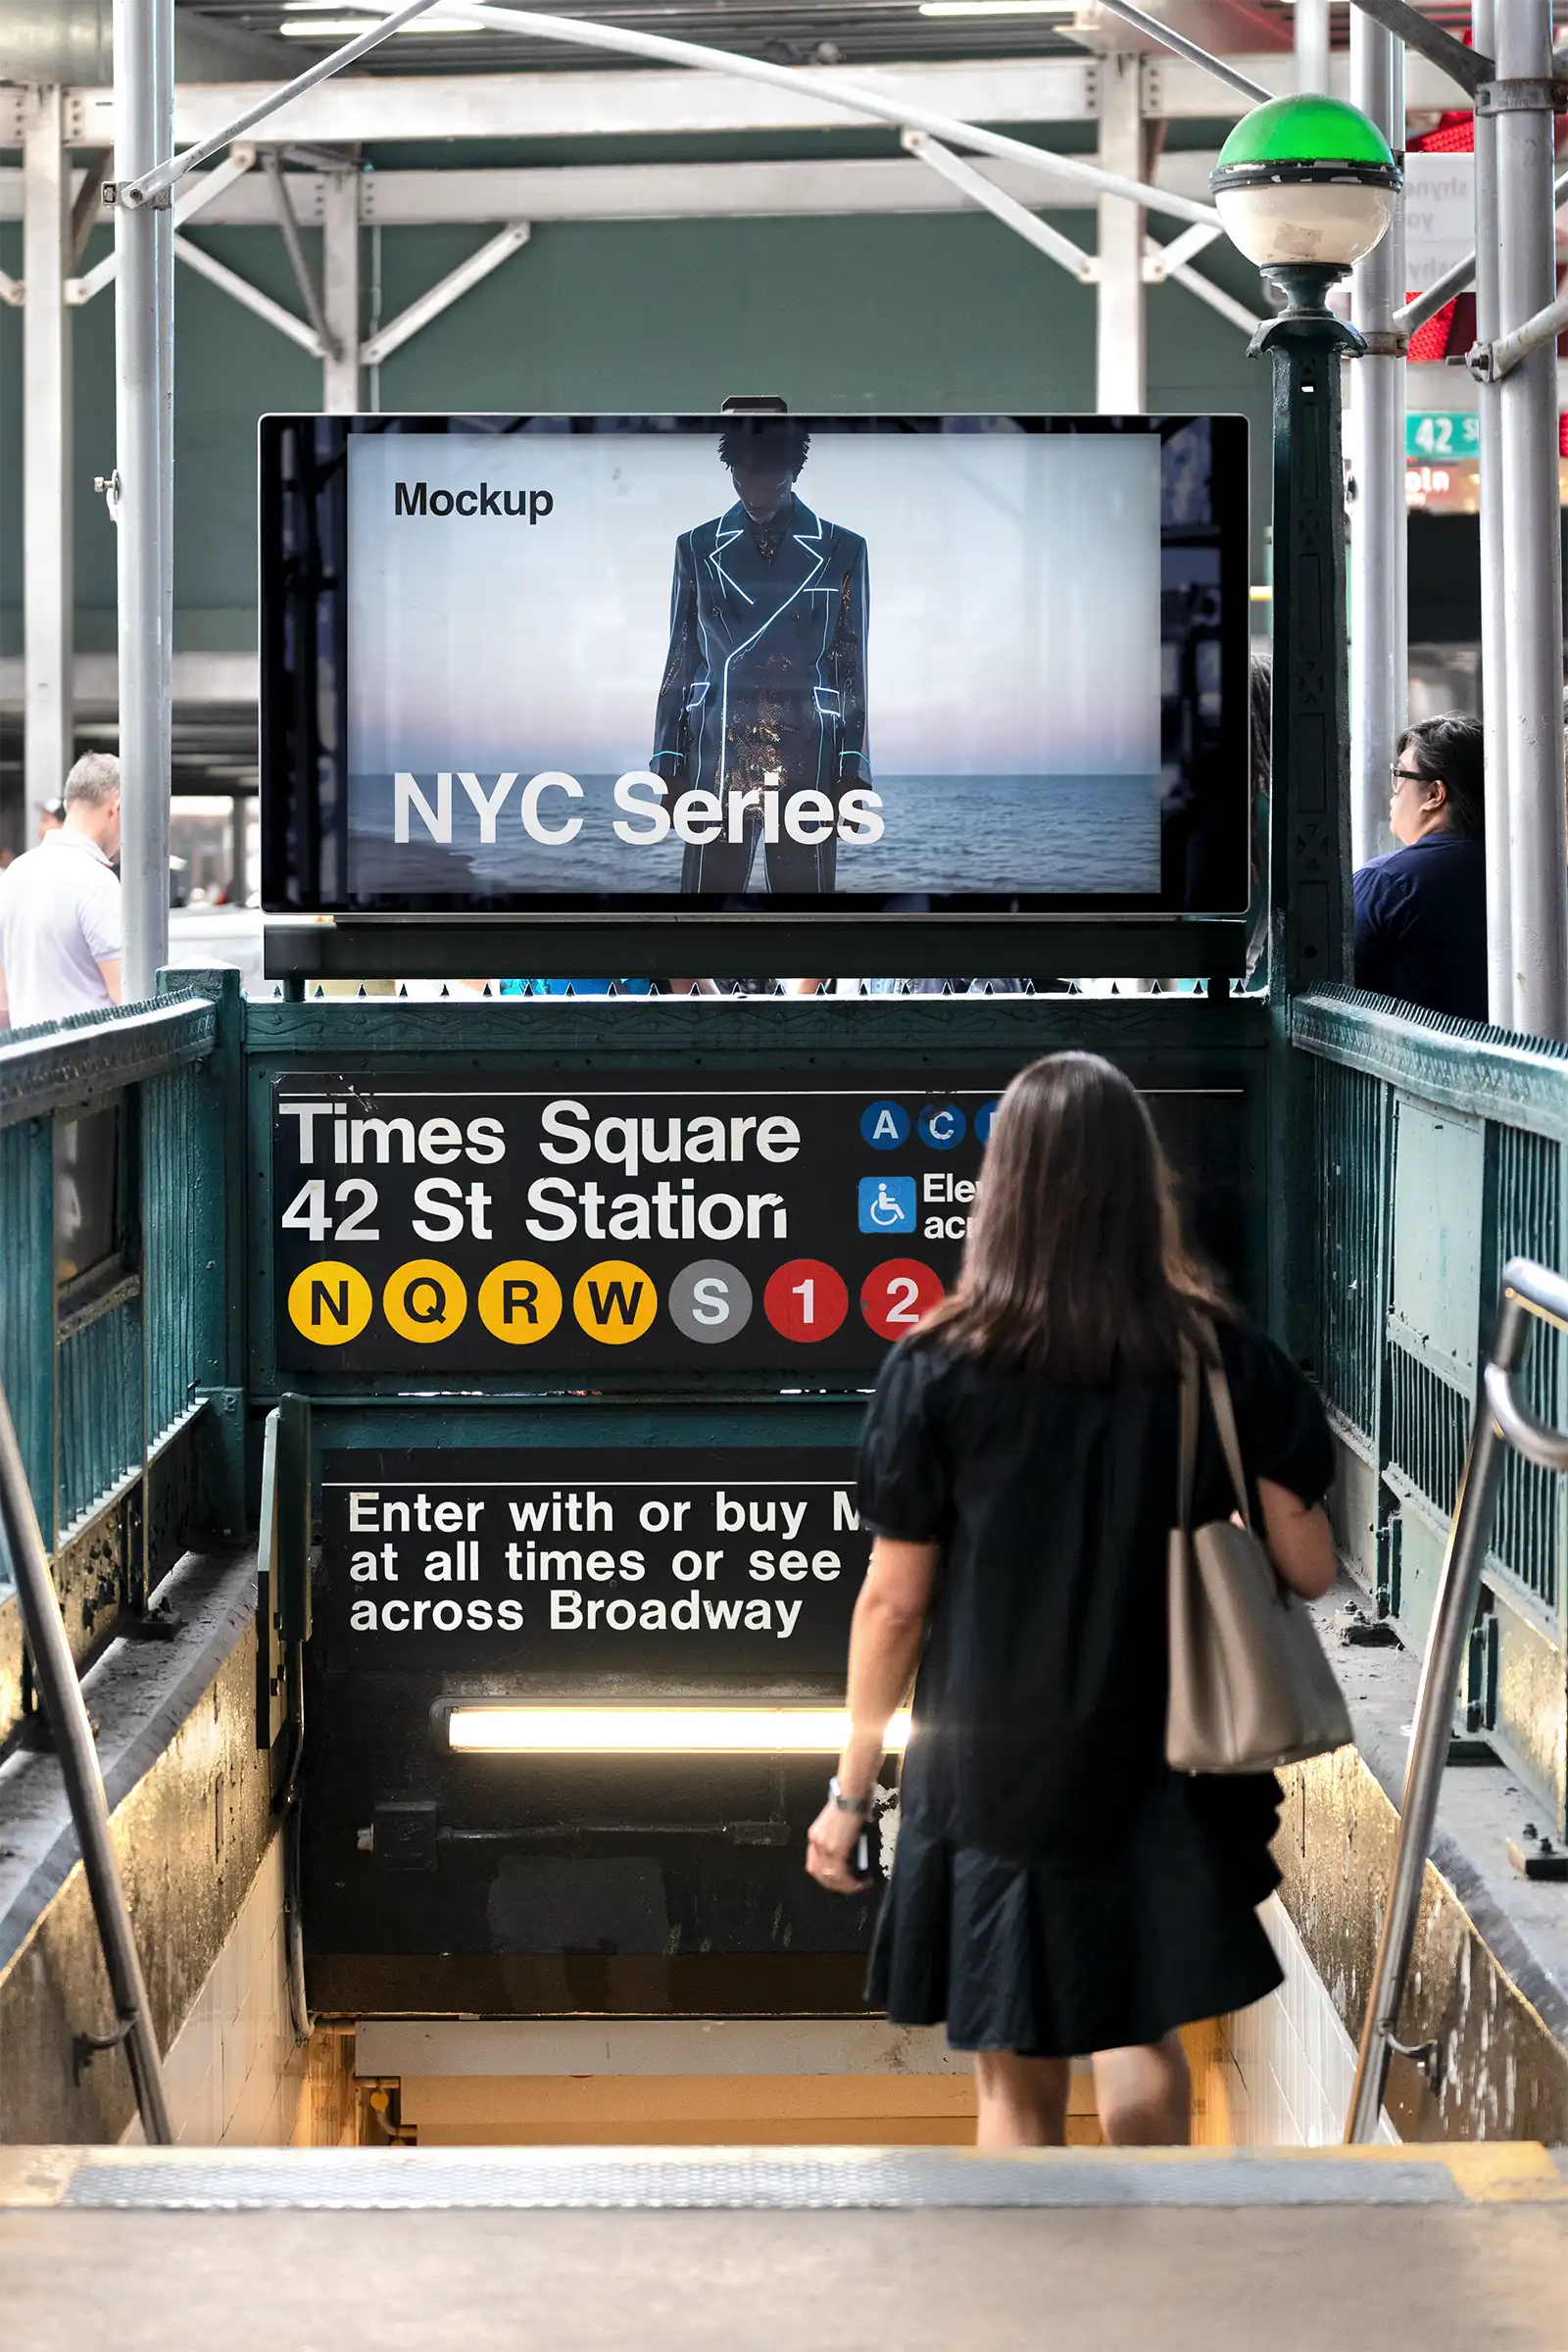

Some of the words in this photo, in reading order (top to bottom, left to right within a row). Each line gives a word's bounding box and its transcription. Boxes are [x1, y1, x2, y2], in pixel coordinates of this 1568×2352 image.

[1415, 417, 1452, 454] 42
[1462, 417, 1479, 442] S
[394, 482, 554, 525] Mockup
[394, 771, 584, 845] NYC
[613, 771, 885, 845] Series
[279, 1102, 506, 1164] Times
[540, 1100, 801, 1175] Square
[873, 1109, 899, 1140] A
[929, 1110, 955, 1141] C
[281, 1179, 380, 1242] 42
[412, 1177, 493, 1242] St
[526, 1177, 787, 1242] Station
[311, 1281, 348, 1325] N
[403, 1278, 446, 1324] Q
[503, 1281, 539, 1324] R
[587, 1281, 644, 1325] W
[692, 1278, 730, 1325] S
[792, 1279, 814, 1323] 1
[886, 1278, 920, 1323] 2
[350, 1492, 485, 1533] Enter
[508, 1491, 613, 1532] with
[640, 1500, 690, 1532] or
[716, 1491, 808, 1540] buy
[833, 1491, 860, 1531] M
[350, 1544, 399, 1582] at
[424, 1541, 479, 1582] all
[505, 1542, 646, 1582] times
[672, 1549, 724, 1581] or
[749, 1549, 842, 1582] see
[350, 1599, 524, 1632] across
[551, 1589, 804, 1639] Broadway
